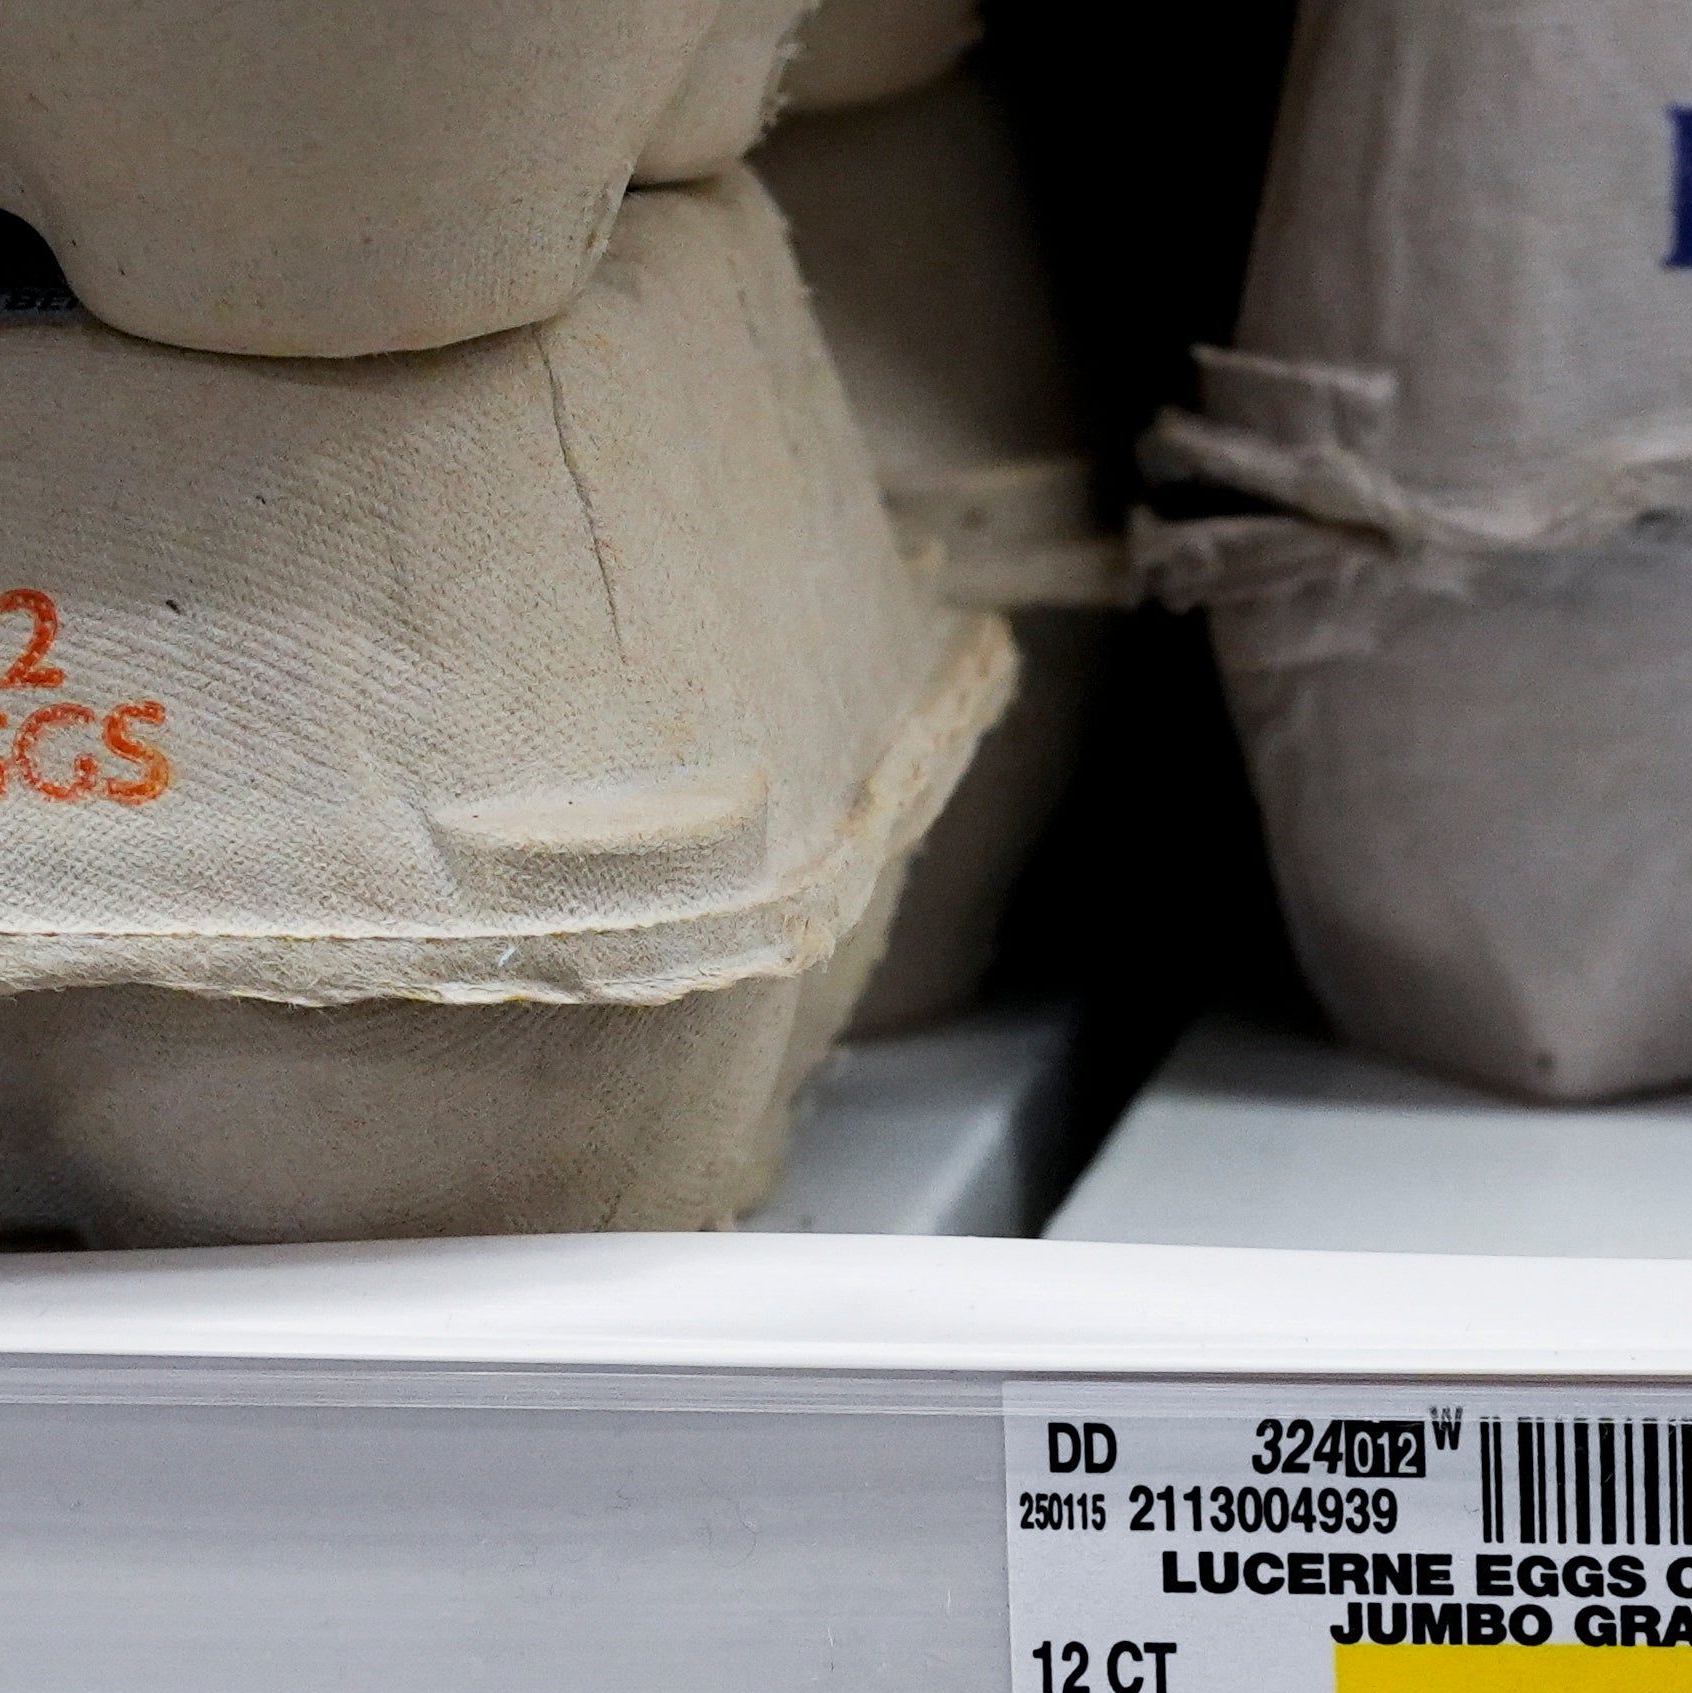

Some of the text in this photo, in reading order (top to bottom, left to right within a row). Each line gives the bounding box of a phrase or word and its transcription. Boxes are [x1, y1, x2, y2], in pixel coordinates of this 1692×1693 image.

[1048, 1423, 1117, 1473] DD
[1020, 1485, 1398, 1534] 250115 2113004939
[1162, 1550, 1454, 1596] LUCERNE
[1476, 1554, 1647, 1599] EGGS
[1330, 1602, 1553, 1646] JUMBO
